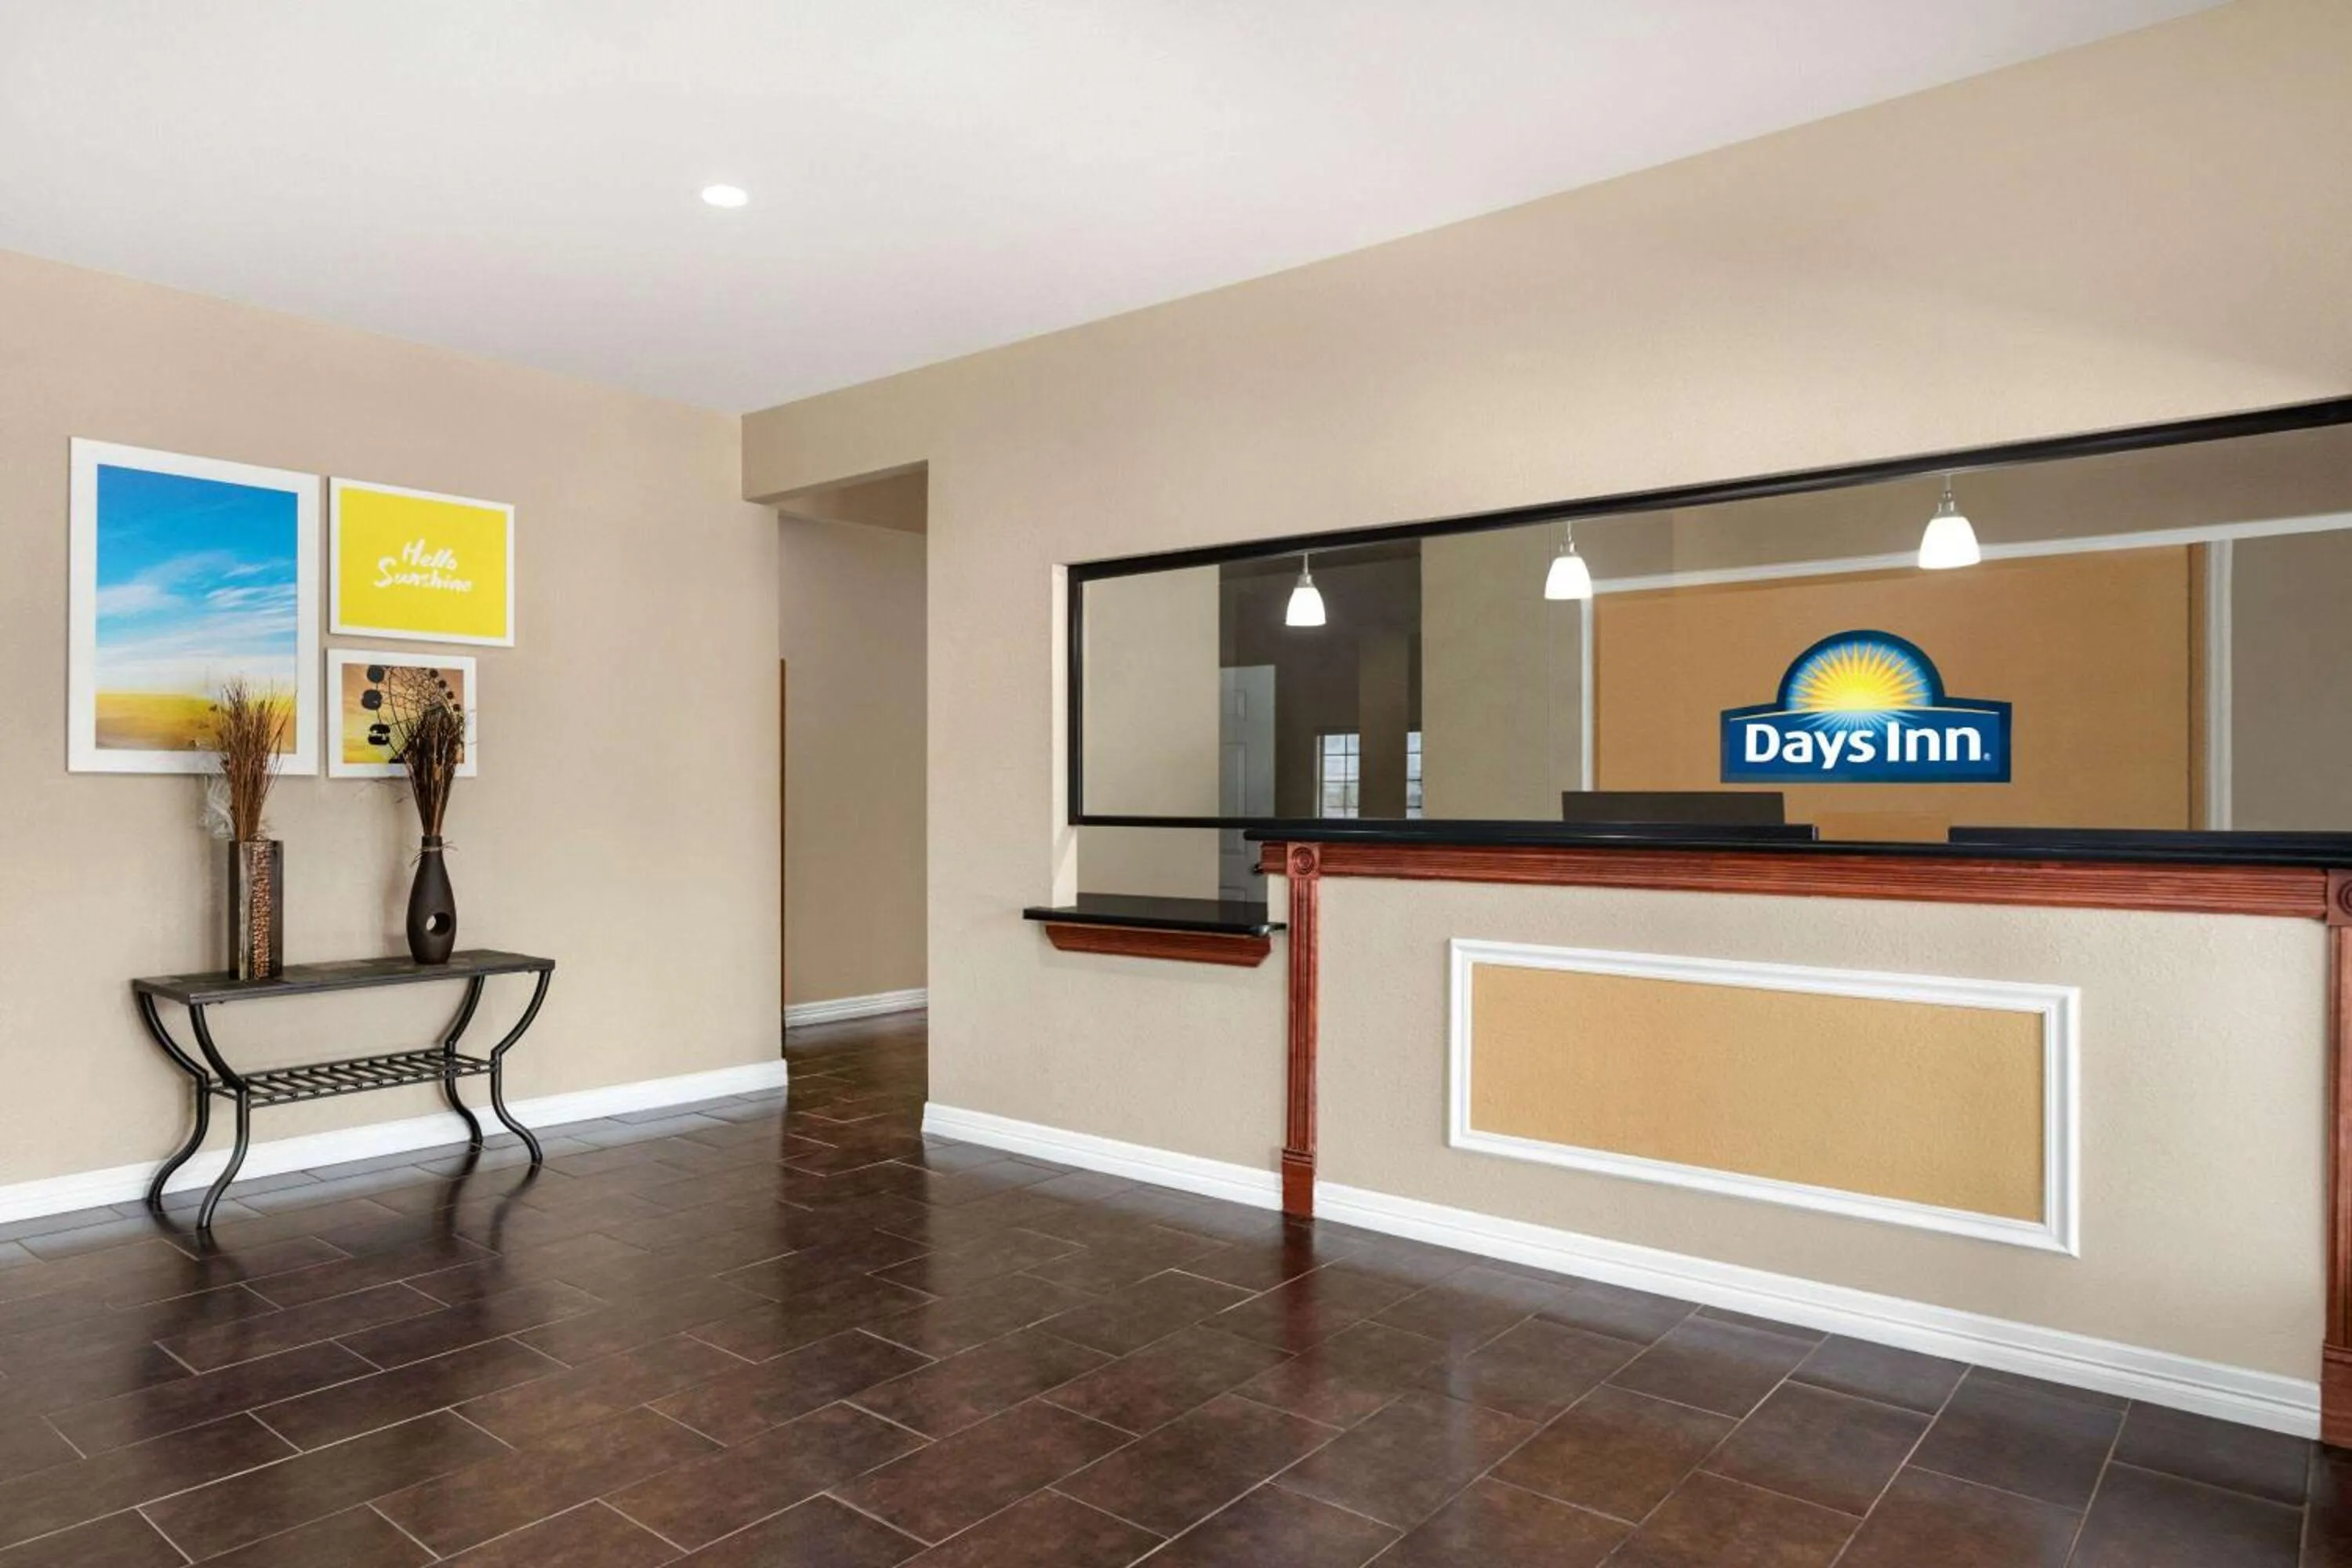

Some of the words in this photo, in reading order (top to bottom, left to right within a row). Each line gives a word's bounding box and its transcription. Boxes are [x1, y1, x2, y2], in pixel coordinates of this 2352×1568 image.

[373, 555, 474, 593] Sunshine
[401, 539, 457, 571] Hello
[1744, 723, 1877, 770] Days
[1886, 721, 1983, 762] Inn
